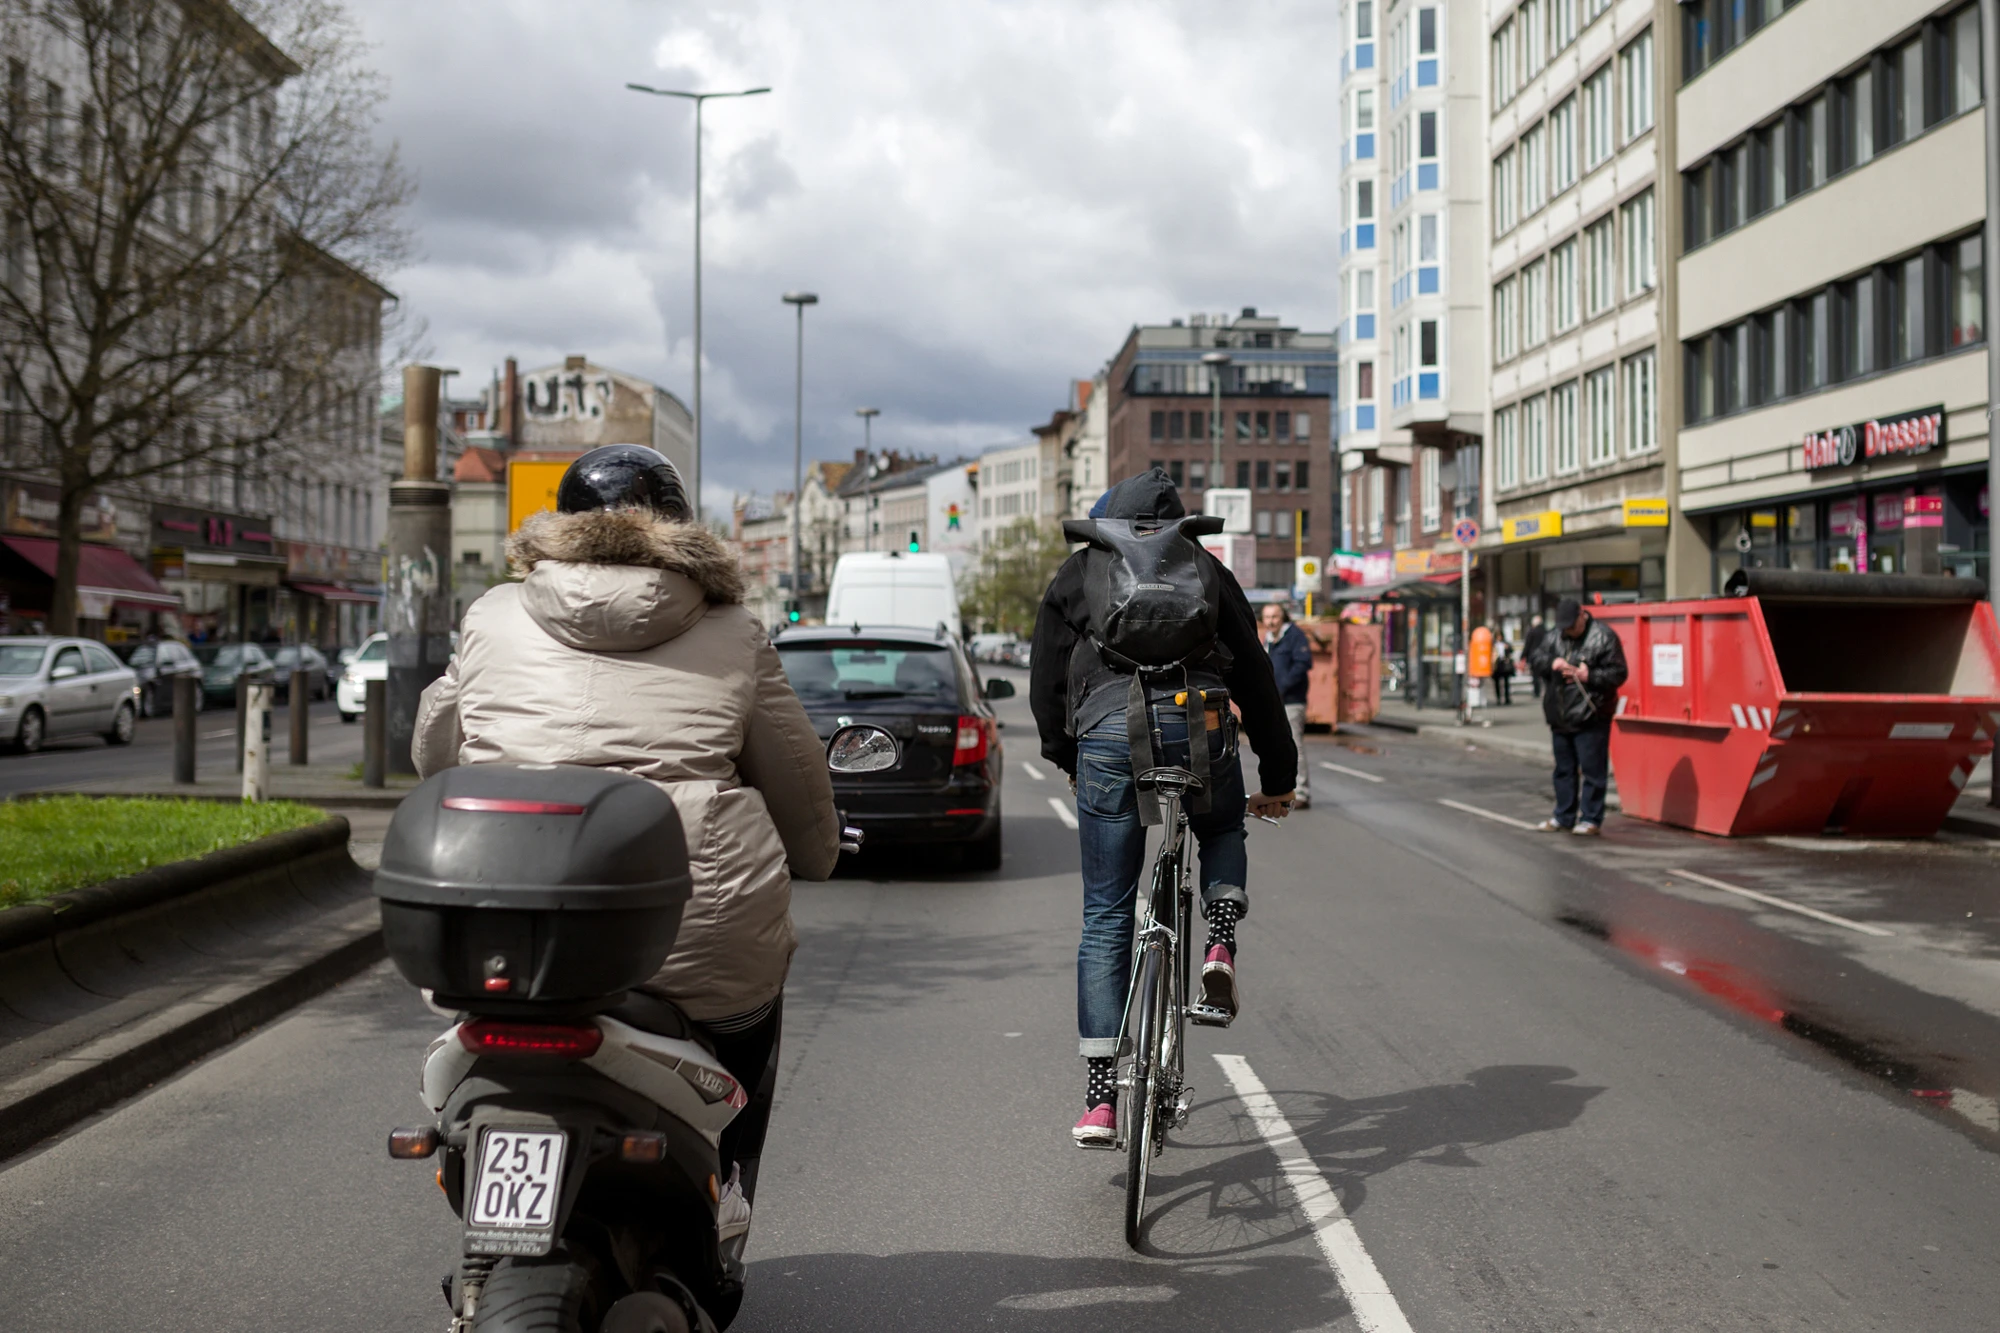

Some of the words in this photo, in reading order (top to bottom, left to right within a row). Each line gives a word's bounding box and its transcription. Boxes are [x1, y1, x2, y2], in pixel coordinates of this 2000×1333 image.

[1803, 428, 1841, 470] Hair
[1864, 412, 1942, 458] Dresser
[487, 1136, 552, 1175] 251
[483, 1181, 548, 1220] OKZ
